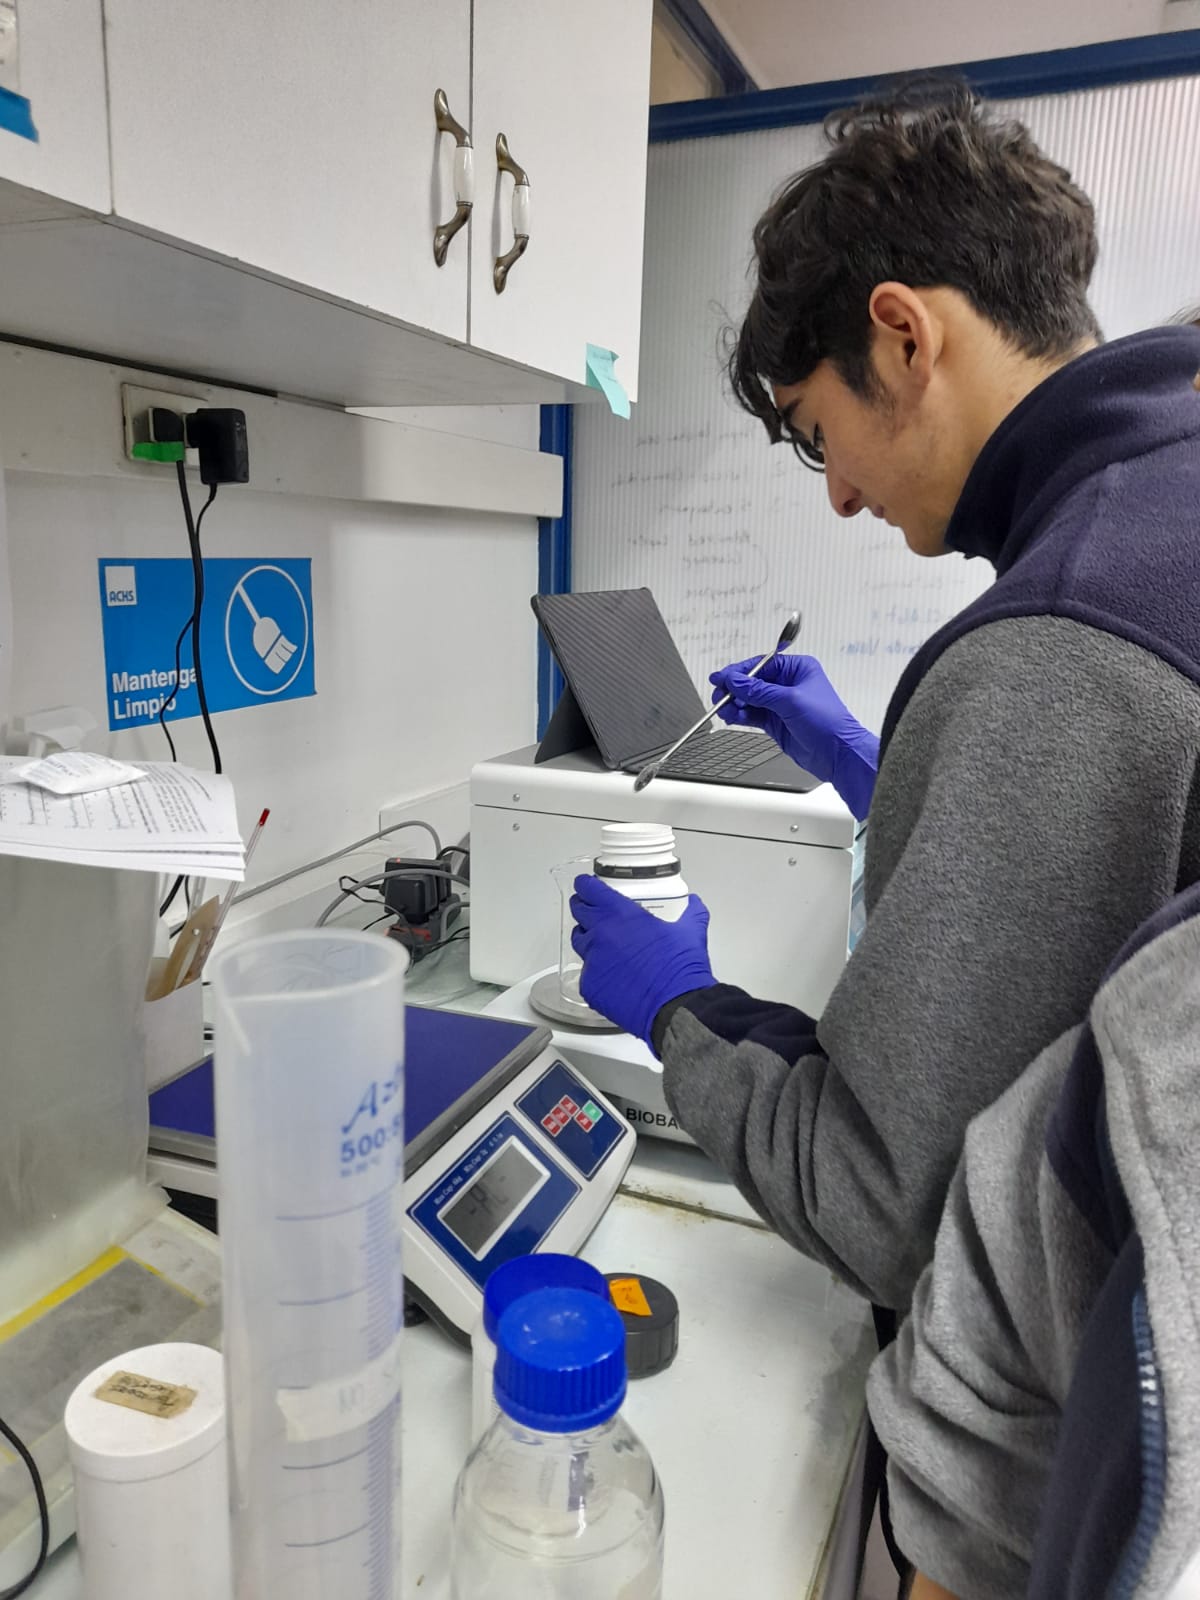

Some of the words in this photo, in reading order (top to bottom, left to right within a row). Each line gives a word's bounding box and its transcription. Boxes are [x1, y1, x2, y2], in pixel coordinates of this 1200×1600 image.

[109, 590, 135, 602] ACHS
[112, 667, 198, 694] Mantenga
[113, 692, 177, 720] Limpio
[626, 1107, 679, 1130] BIOBA
